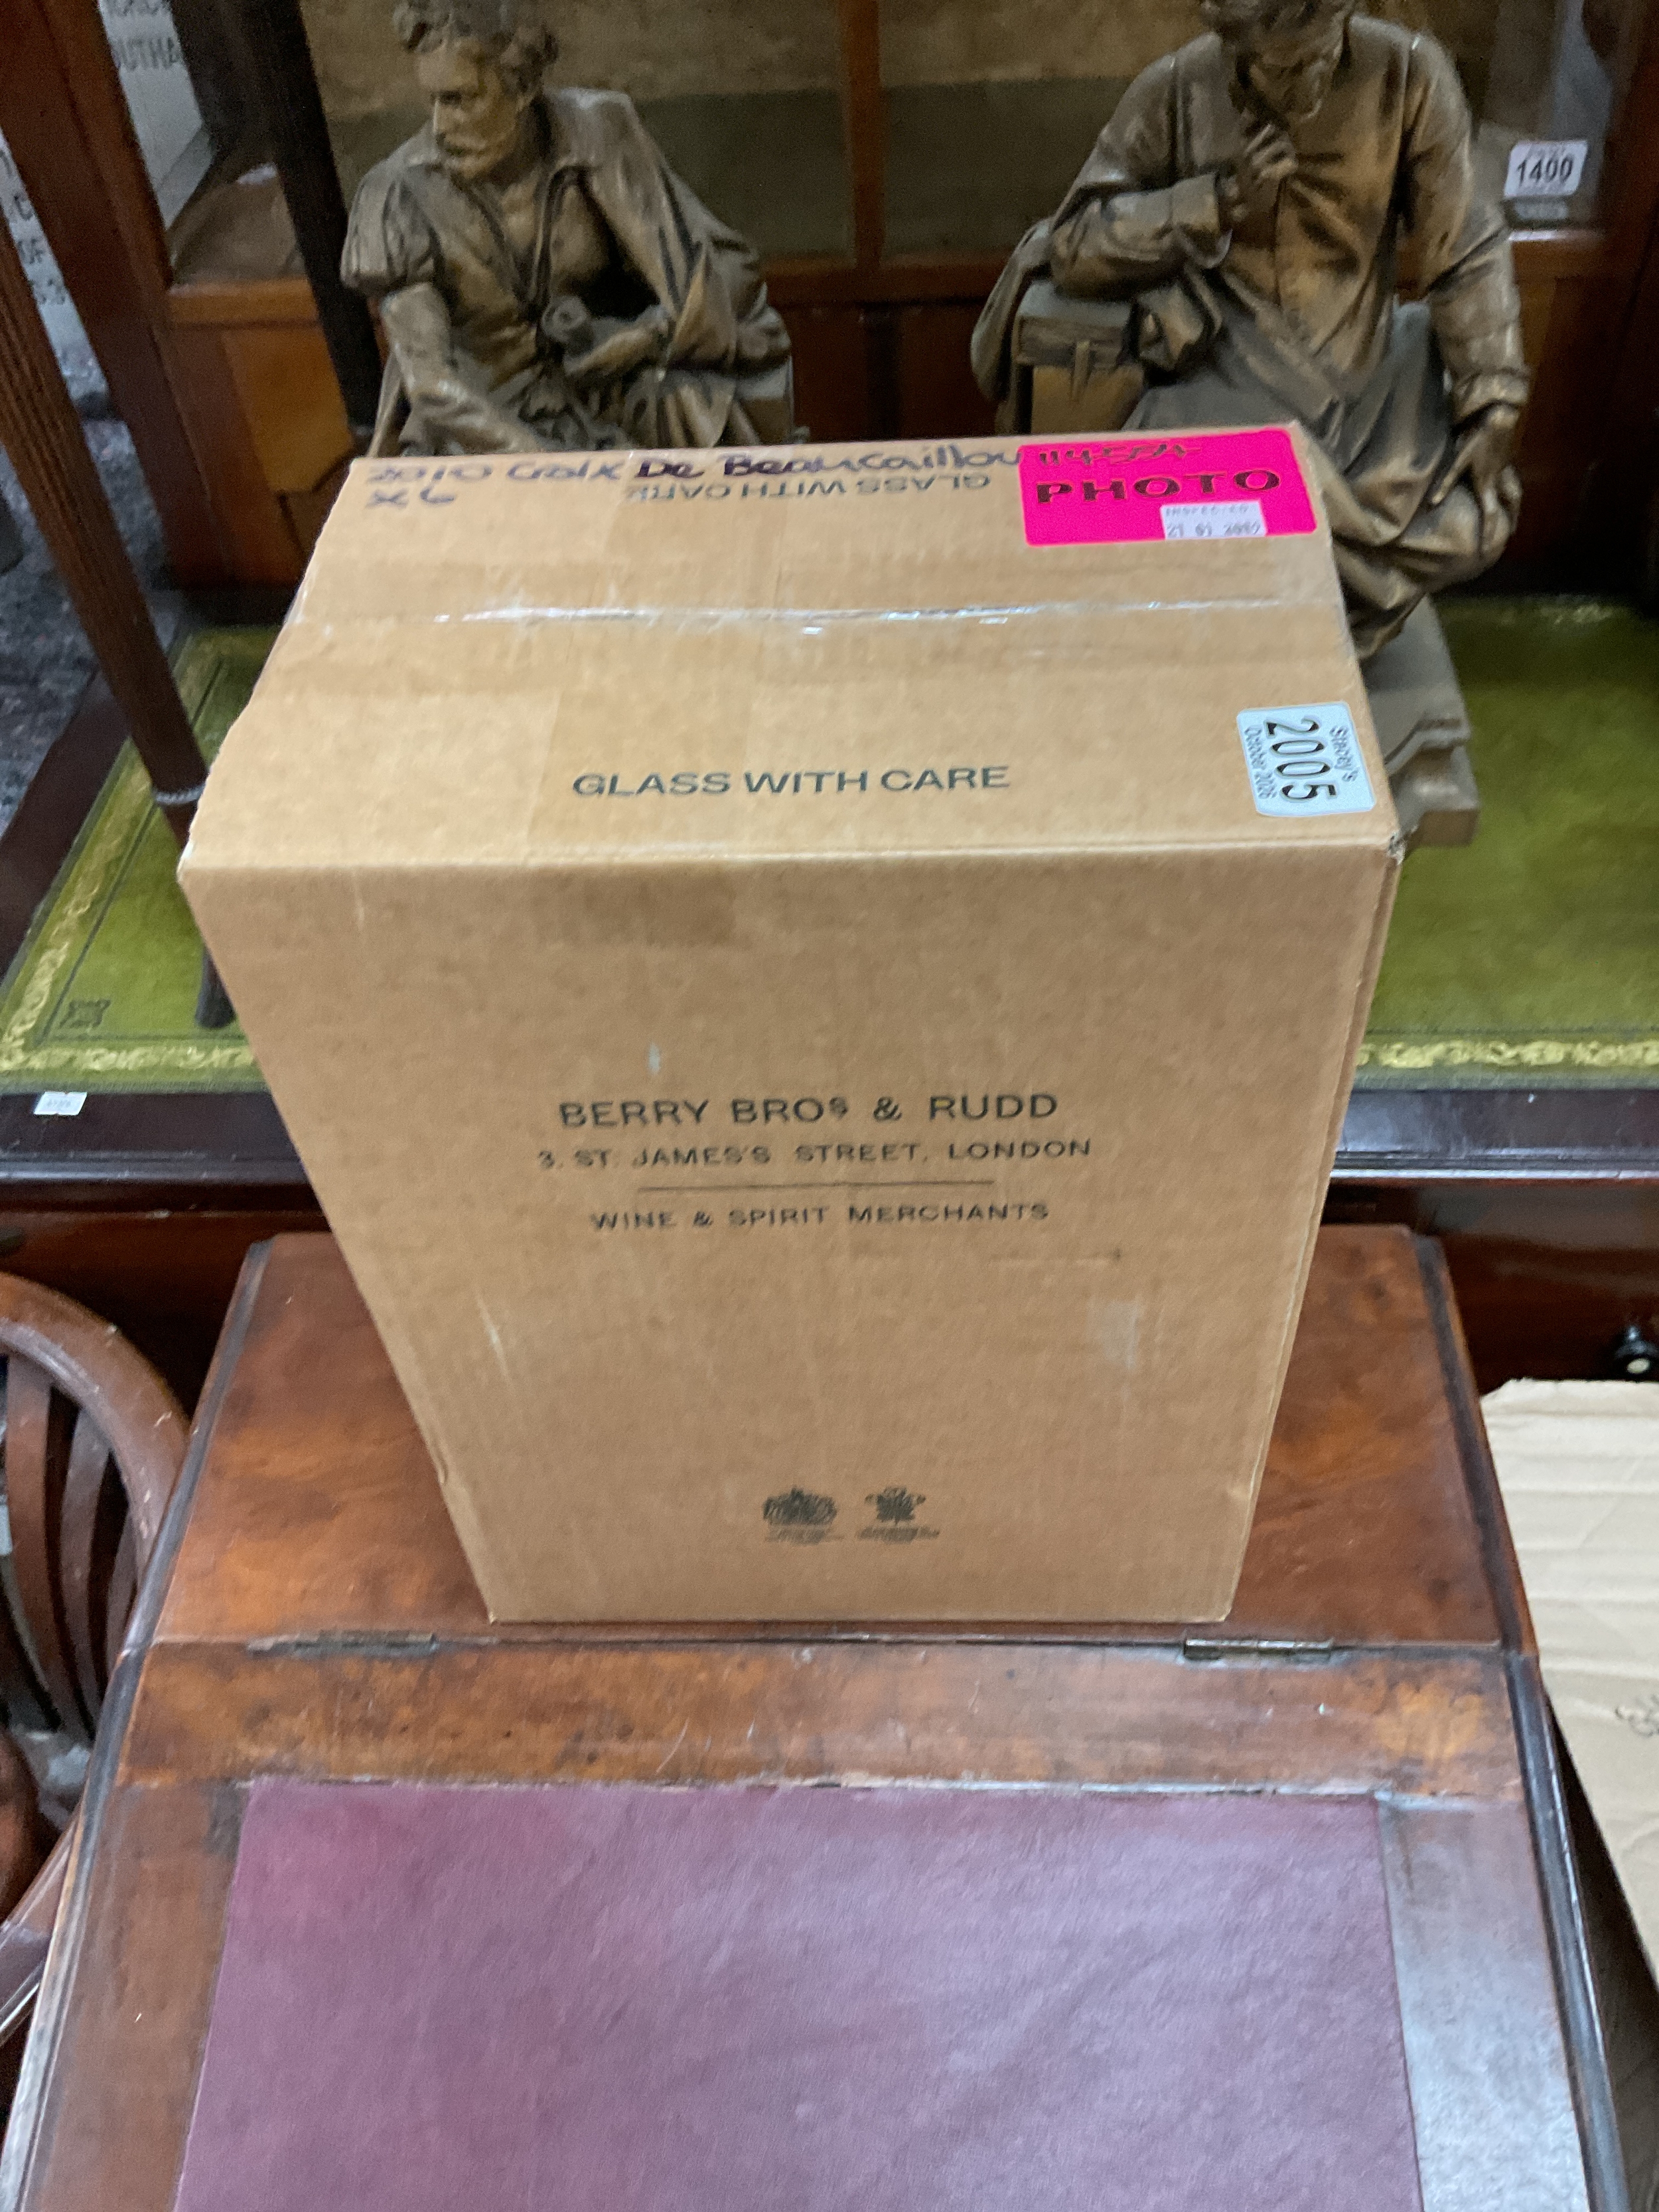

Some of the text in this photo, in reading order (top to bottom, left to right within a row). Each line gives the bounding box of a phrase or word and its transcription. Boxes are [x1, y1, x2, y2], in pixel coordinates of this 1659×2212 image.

[741, 479, 847, 499] WITH
[857, 473, 991, 495] GLASS
[1036, 469, 1281, 504] PHOTO
[1264, 715, 1337, 801] 2005
[572, 765, 1011, 797] GLASS WITH CARE
[559, 1098, 709, 1127] BERRY
[873, 1096, 902, 1122] &
[929, 1092, 1058, 1121] RUDD
[948, 1138, 1091, 1161] LONDON
[590, 1203, 1049, 1230] WINE & SPIRIT MERCHANTS
